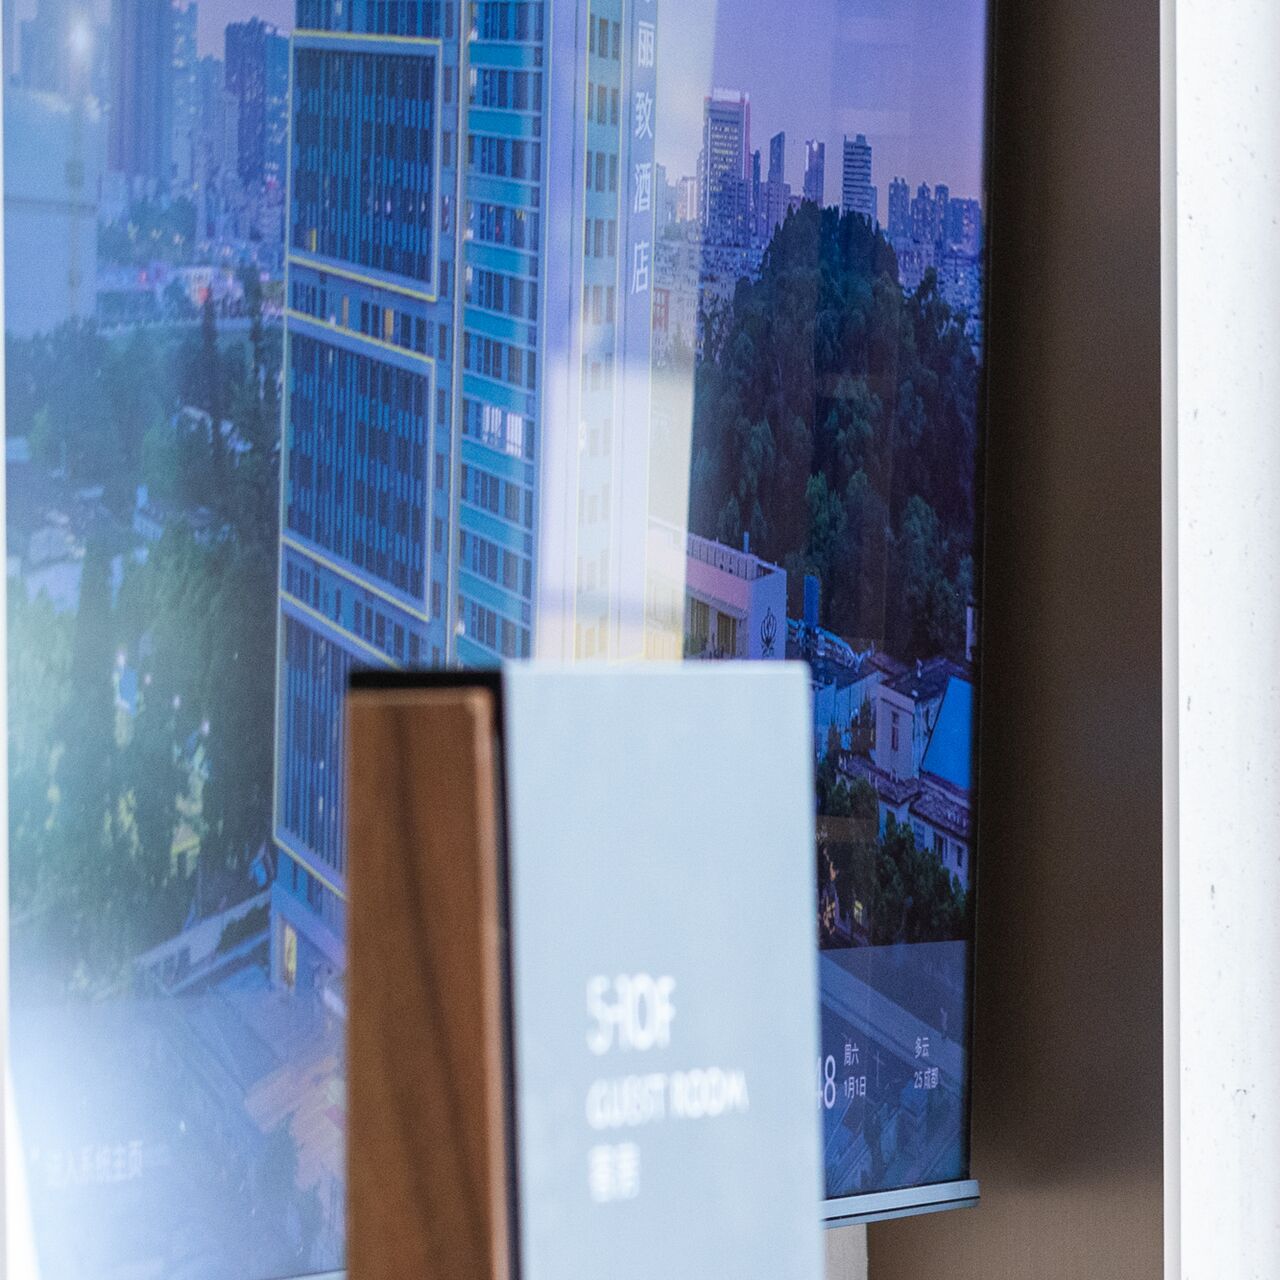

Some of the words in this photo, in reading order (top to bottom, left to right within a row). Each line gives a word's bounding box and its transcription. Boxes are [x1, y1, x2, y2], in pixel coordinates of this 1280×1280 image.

[843, 1043, 860, 1066] 周六
[914, 1036, 930, 1059] 多云
[843, 1076, 866, 1100] 1月1日
